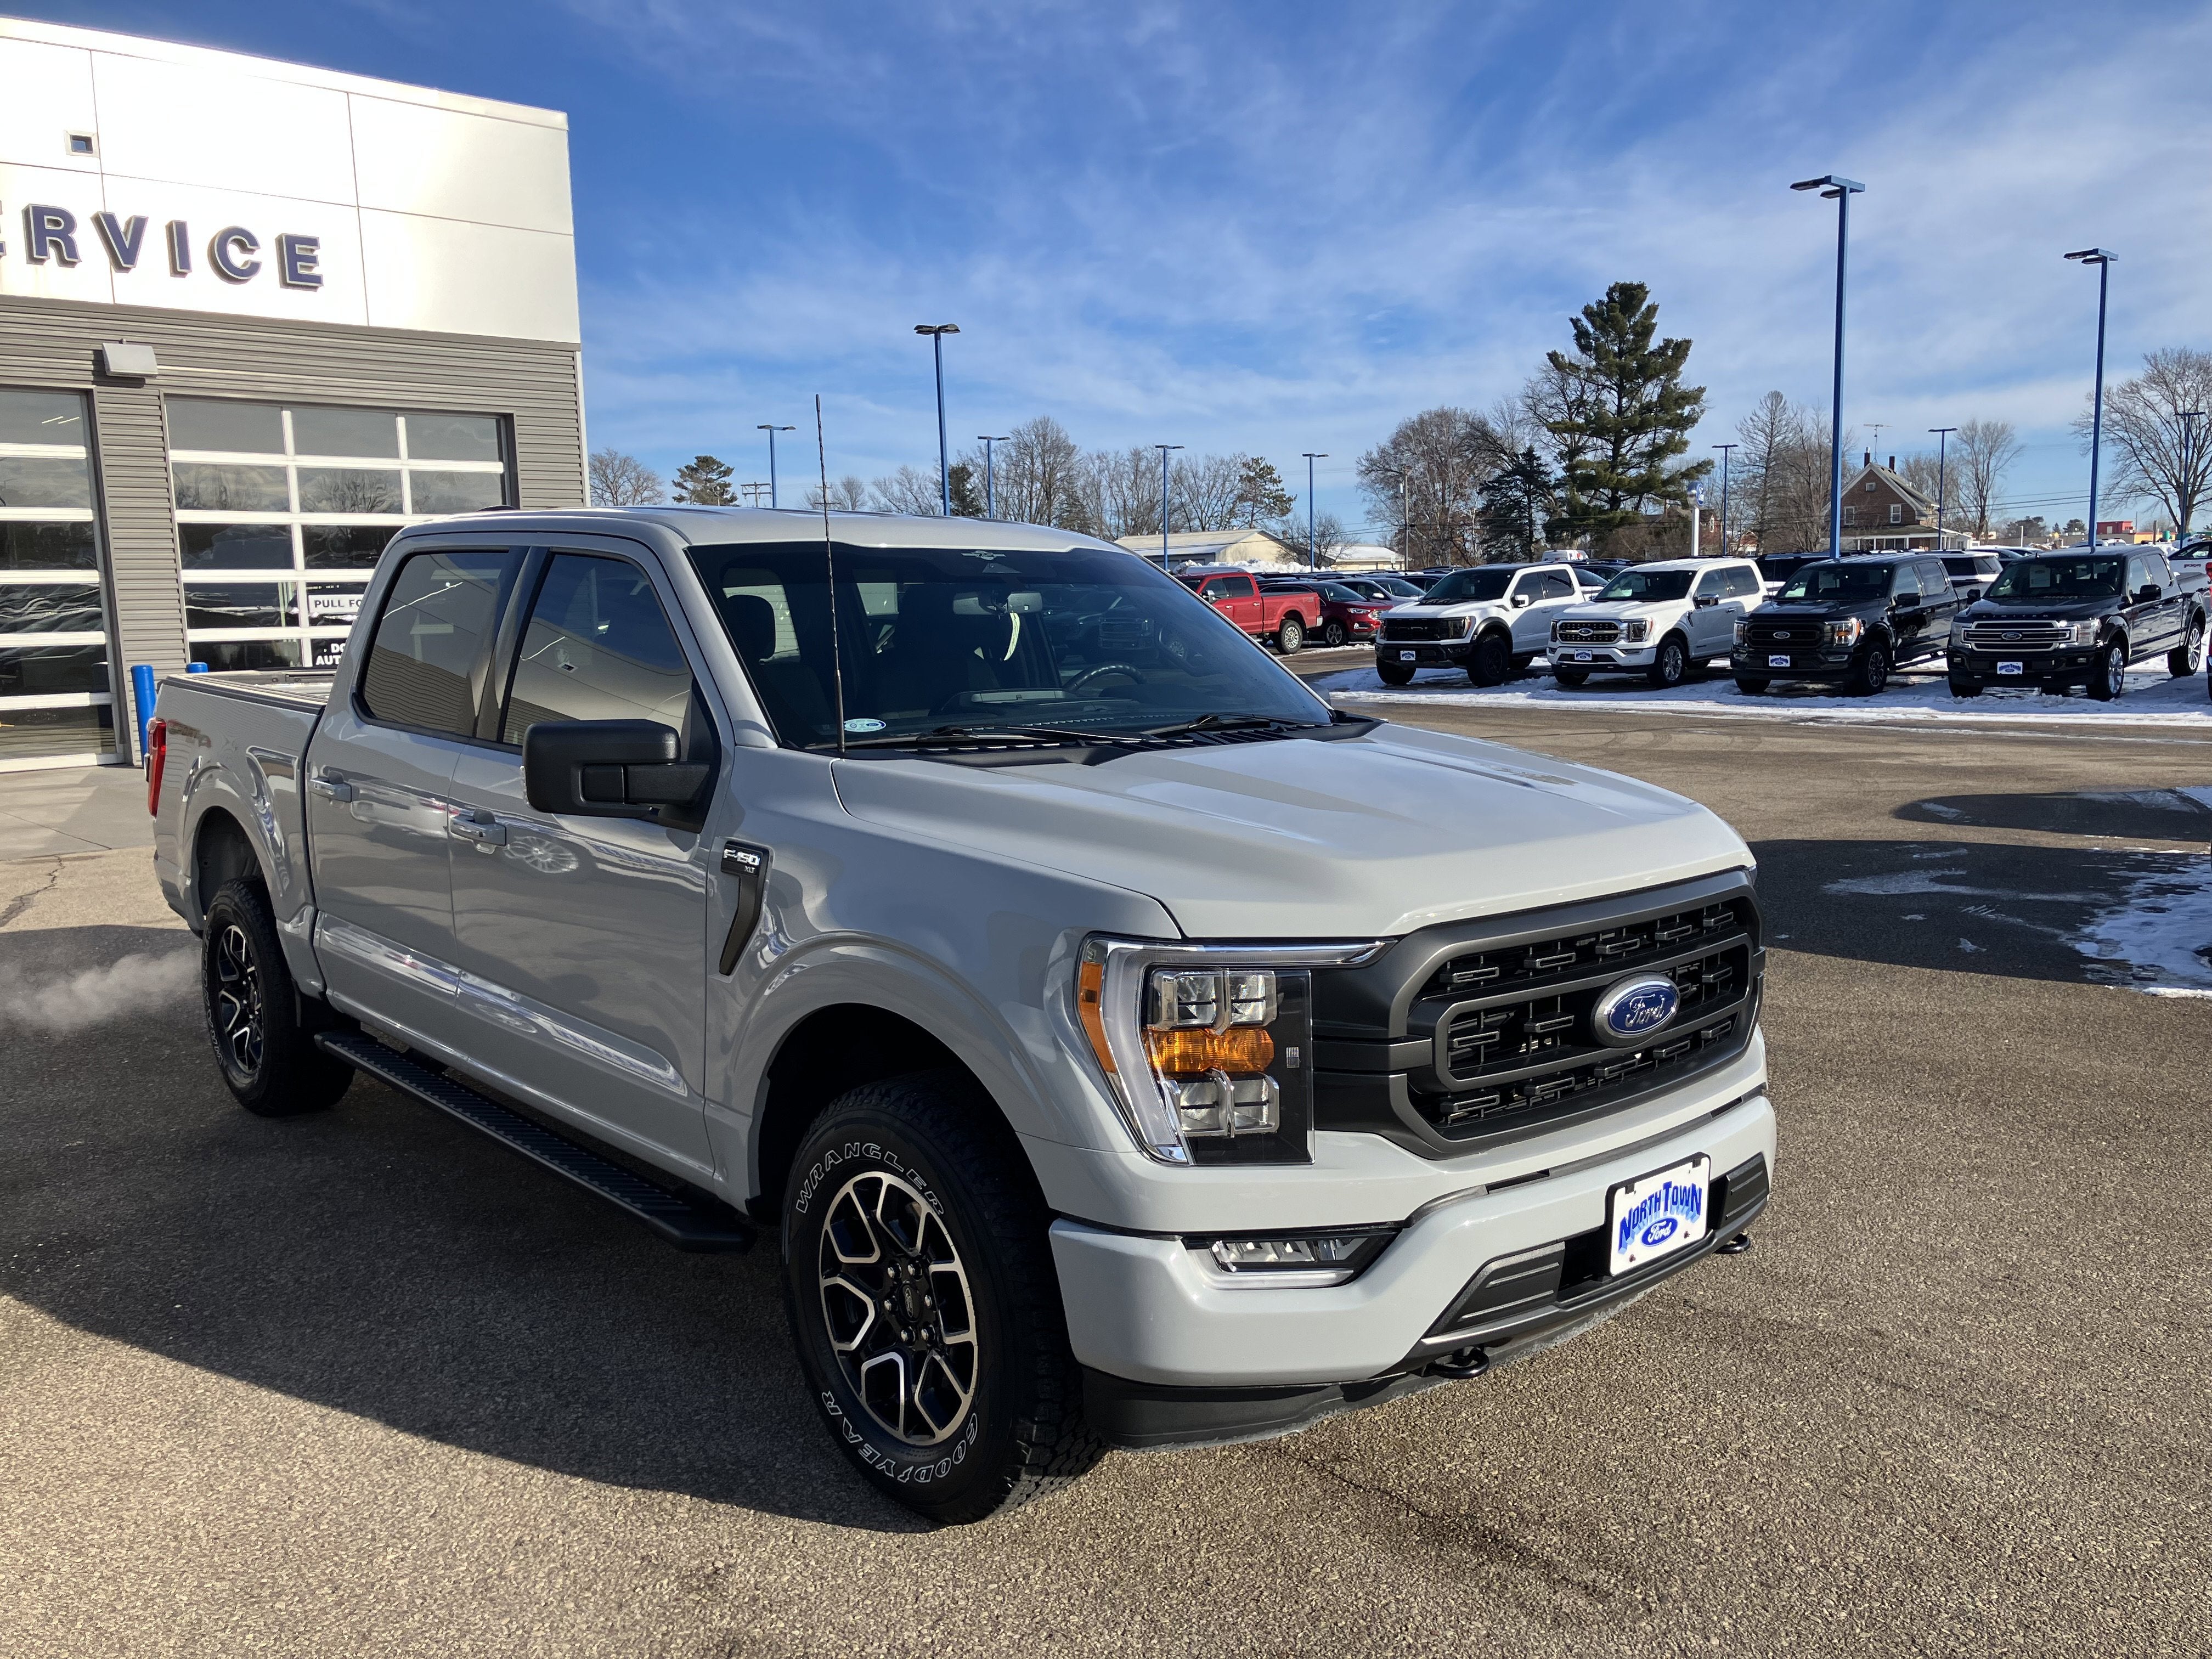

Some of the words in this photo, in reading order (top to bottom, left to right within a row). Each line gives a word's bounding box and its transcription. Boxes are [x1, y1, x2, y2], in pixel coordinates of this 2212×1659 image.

[0, 201, 325, 292] RVICE
[314, 600, 345, 608] PULL
[1625, 994, 1666, 1028] Ford
[795, 1142, 944, 1216] WRANGLER
[1649, 1221, 1671, 1242] Ford
[822, 1391, 978, 1483] GOODYEAR
